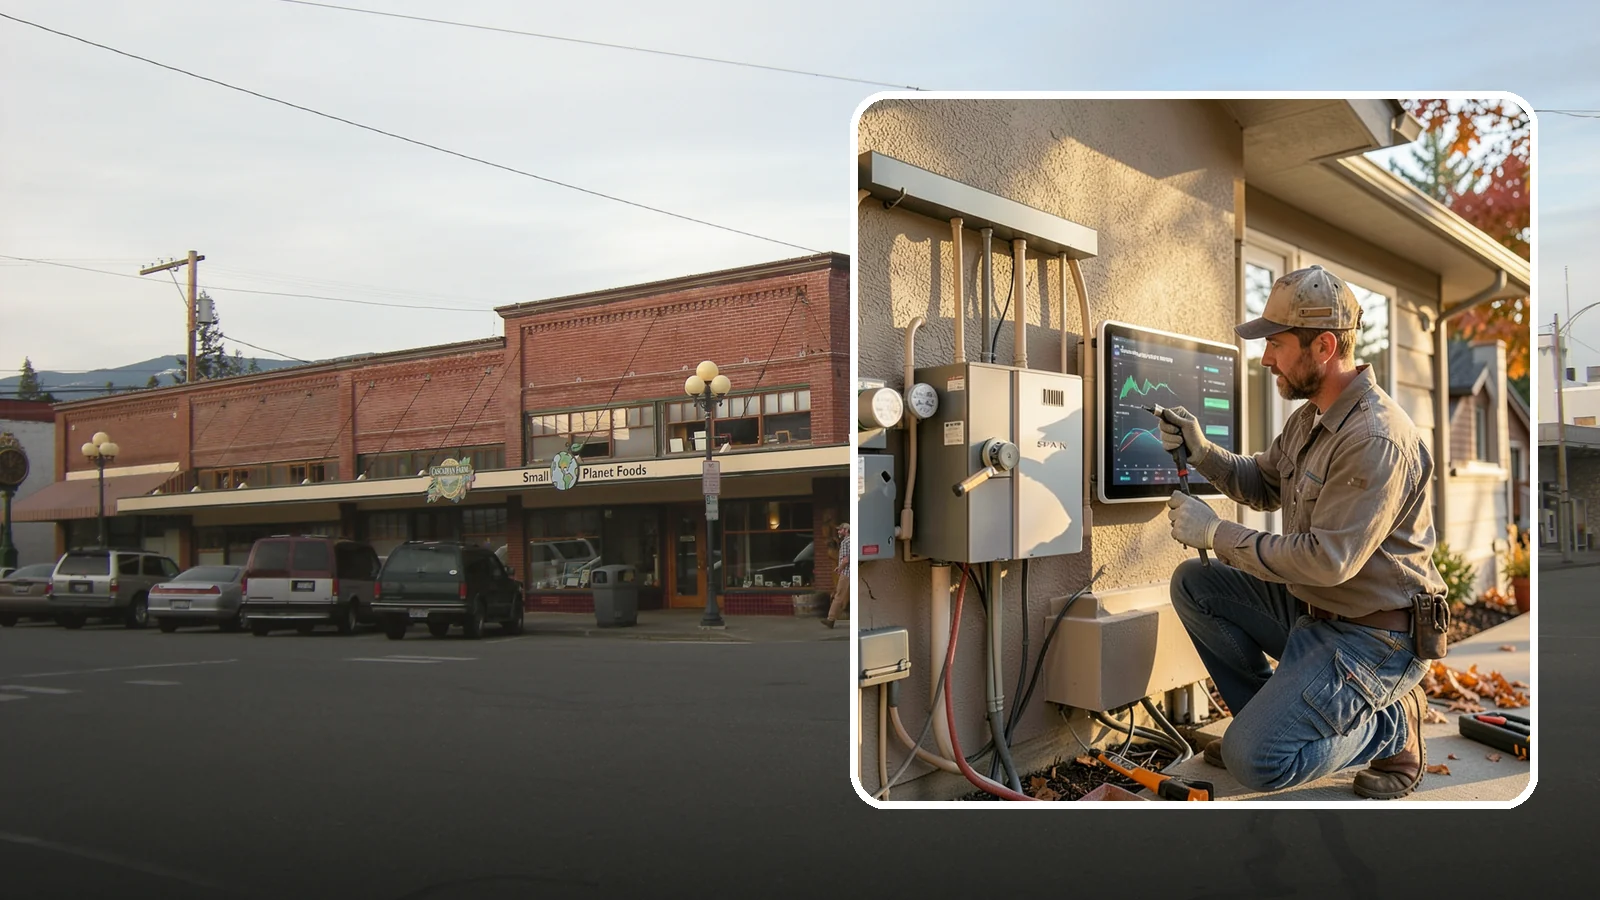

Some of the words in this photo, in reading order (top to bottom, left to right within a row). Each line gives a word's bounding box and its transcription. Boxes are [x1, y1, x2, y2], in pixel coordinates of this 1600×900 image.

[1036, 440, 1067, 450] SPAN
[523, 471, 549, 483] Small
[583, 467, 614, 479] Planet
[617, 464, 647, 477] Foods
